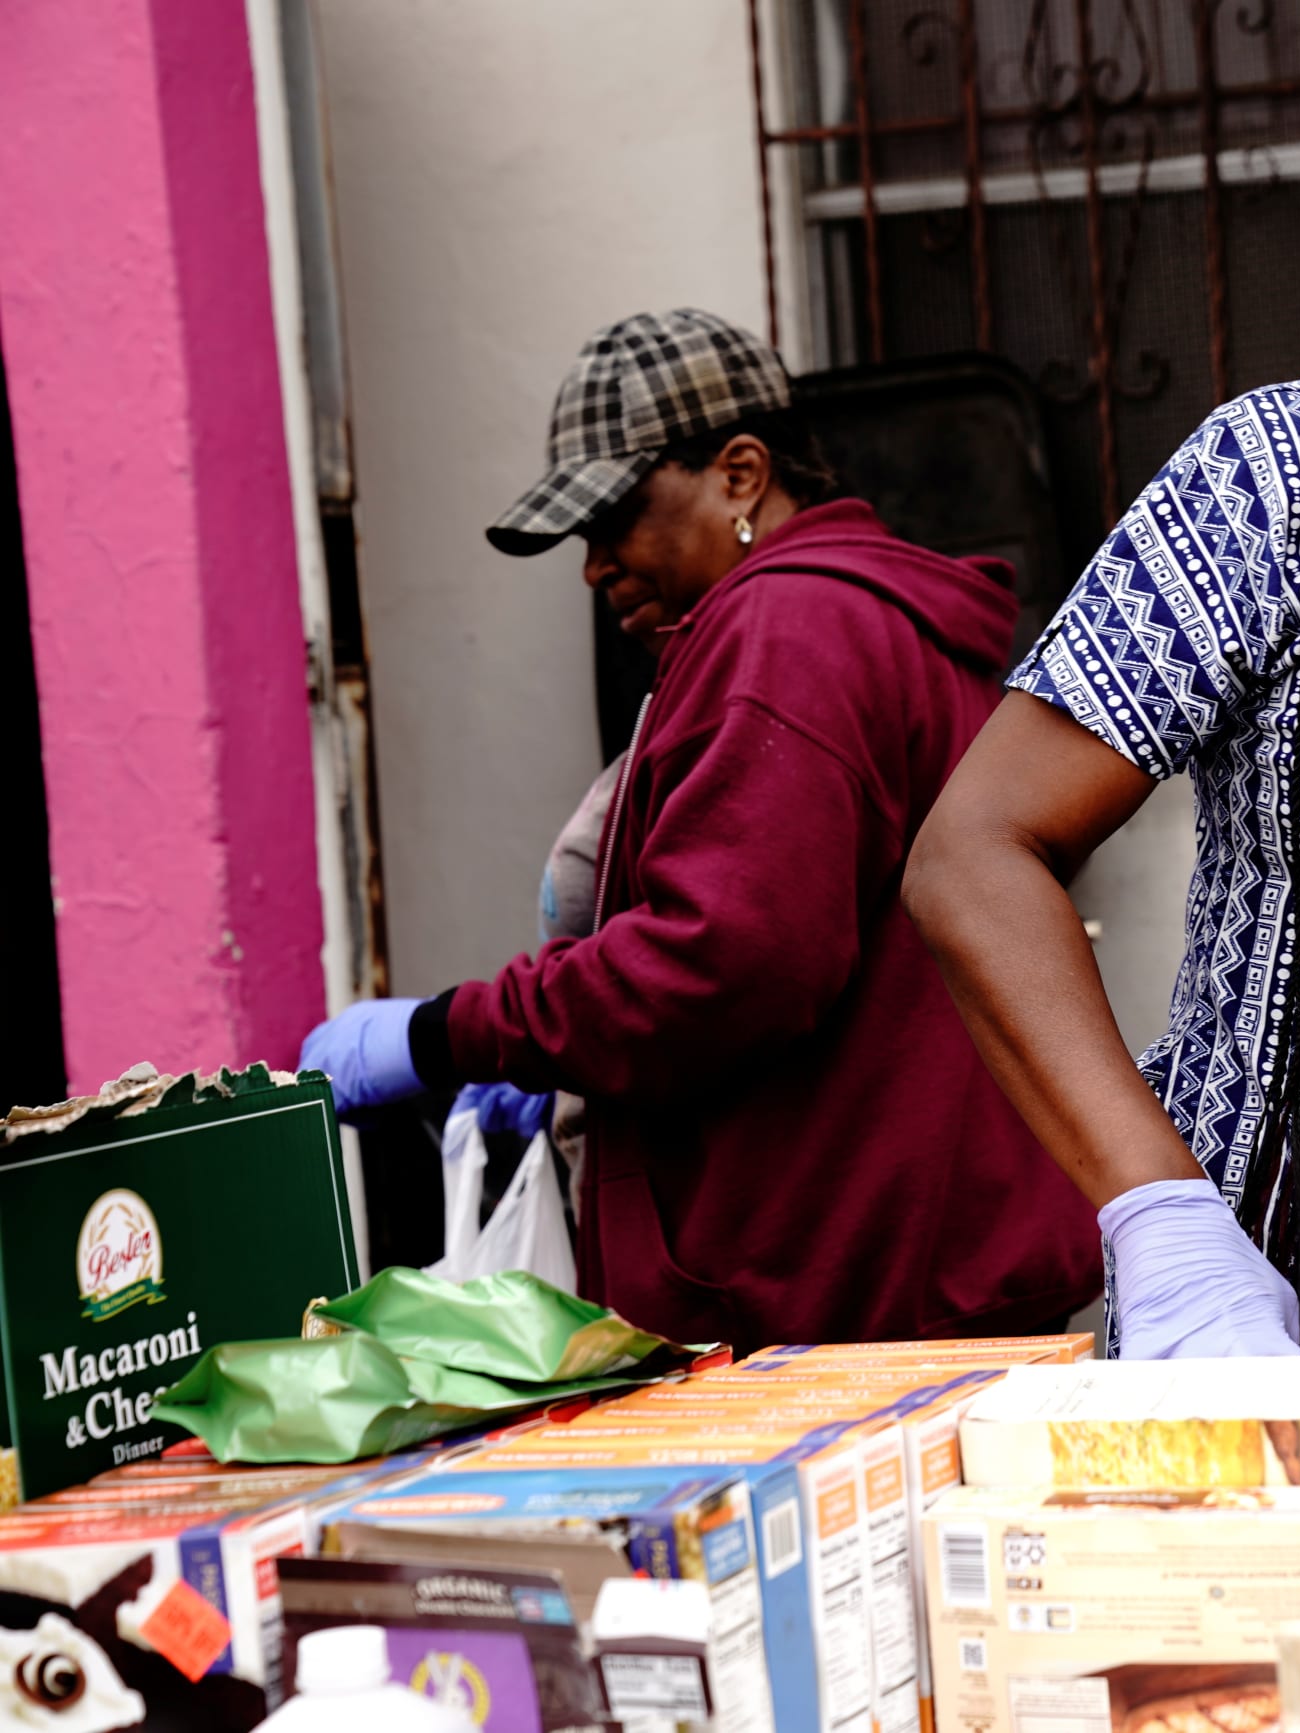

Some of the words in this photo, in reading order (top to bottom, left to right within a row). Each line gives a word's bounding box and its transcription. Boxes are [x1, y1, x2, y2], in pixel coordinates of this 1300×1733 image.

[87, 1231, 152, 1289] Besler
[39, 1311, 202, 1400] Macaroni
[112, 1435, 164, 1465] Dinner
